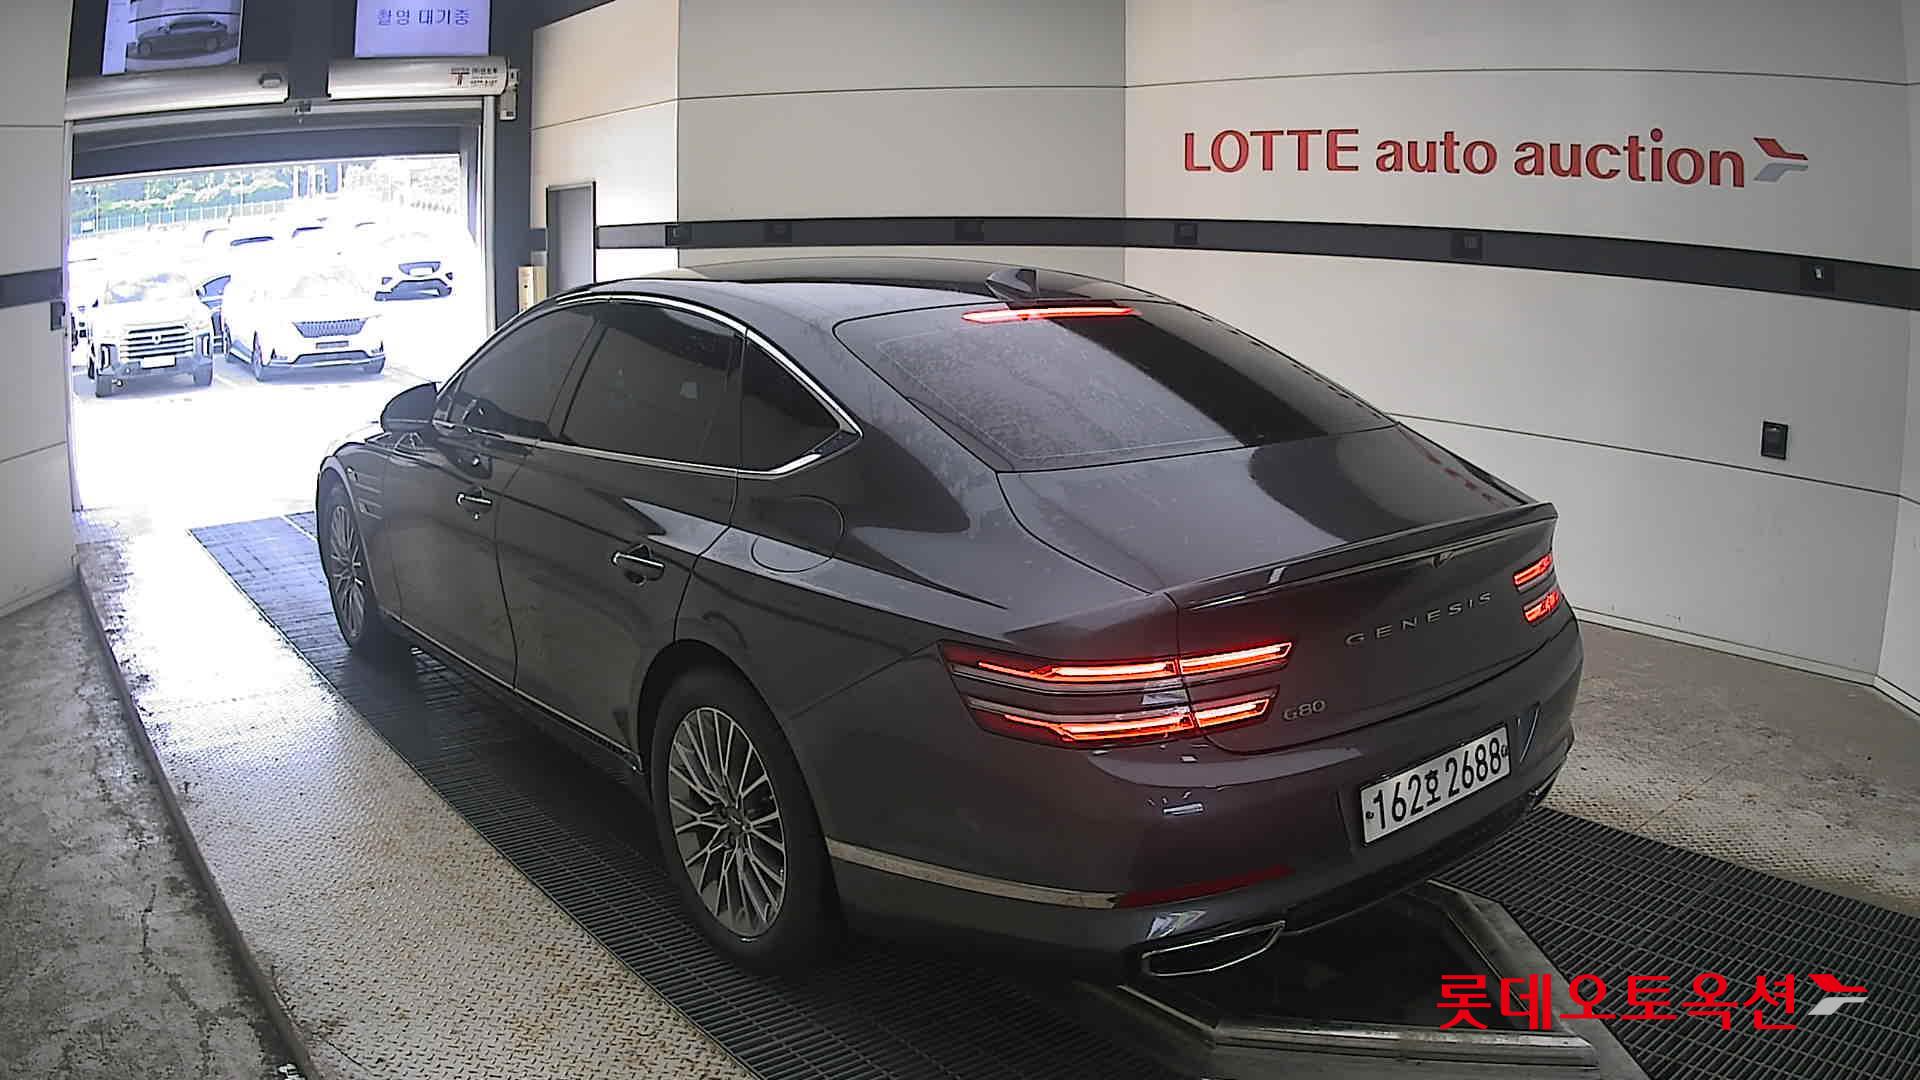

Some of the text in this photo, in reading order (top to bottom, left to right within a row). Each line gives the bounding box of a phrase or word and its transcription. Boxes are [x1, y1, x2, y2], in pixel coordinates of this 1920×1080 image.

[418, 9, 471, 26] 대기중
[1183, 127, 1746, 188] LOTTE auto auction
[1344, 591, 1492, 646] GENESIS
[1282, 699, 1327, 721] G80
[1445, 737, 1501, 798] 2688
